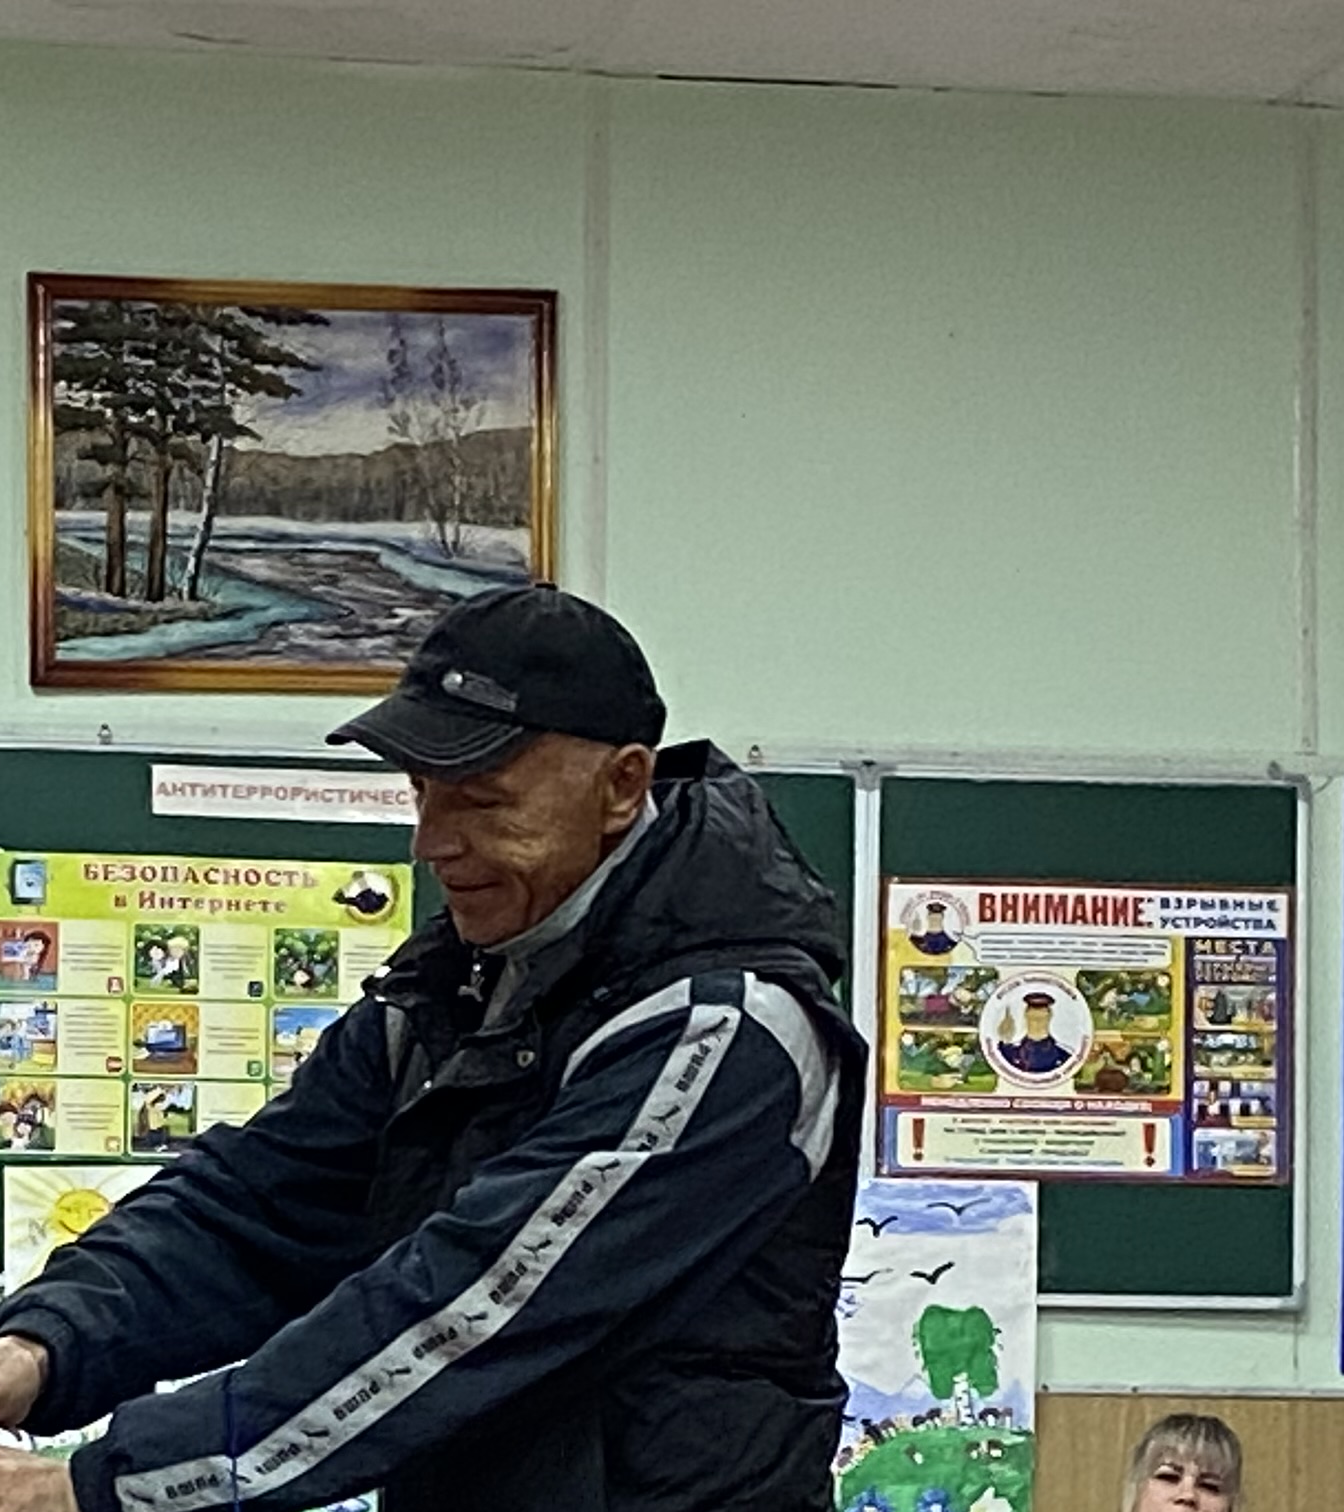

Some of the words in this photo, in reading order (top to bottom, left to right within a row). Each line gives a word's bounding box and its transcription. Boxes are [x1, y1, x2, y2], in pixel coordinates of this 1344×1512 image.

[156, 782, 410, 806] АНТИТЕРРОРИСТИЧЕС
[83, 863, 318, 888] БЕЗОПАСНОСТЬ
[138, 890, 287, 914] Интернете
[1160, 914, 1277, 931] УСТРОЙСТВА
